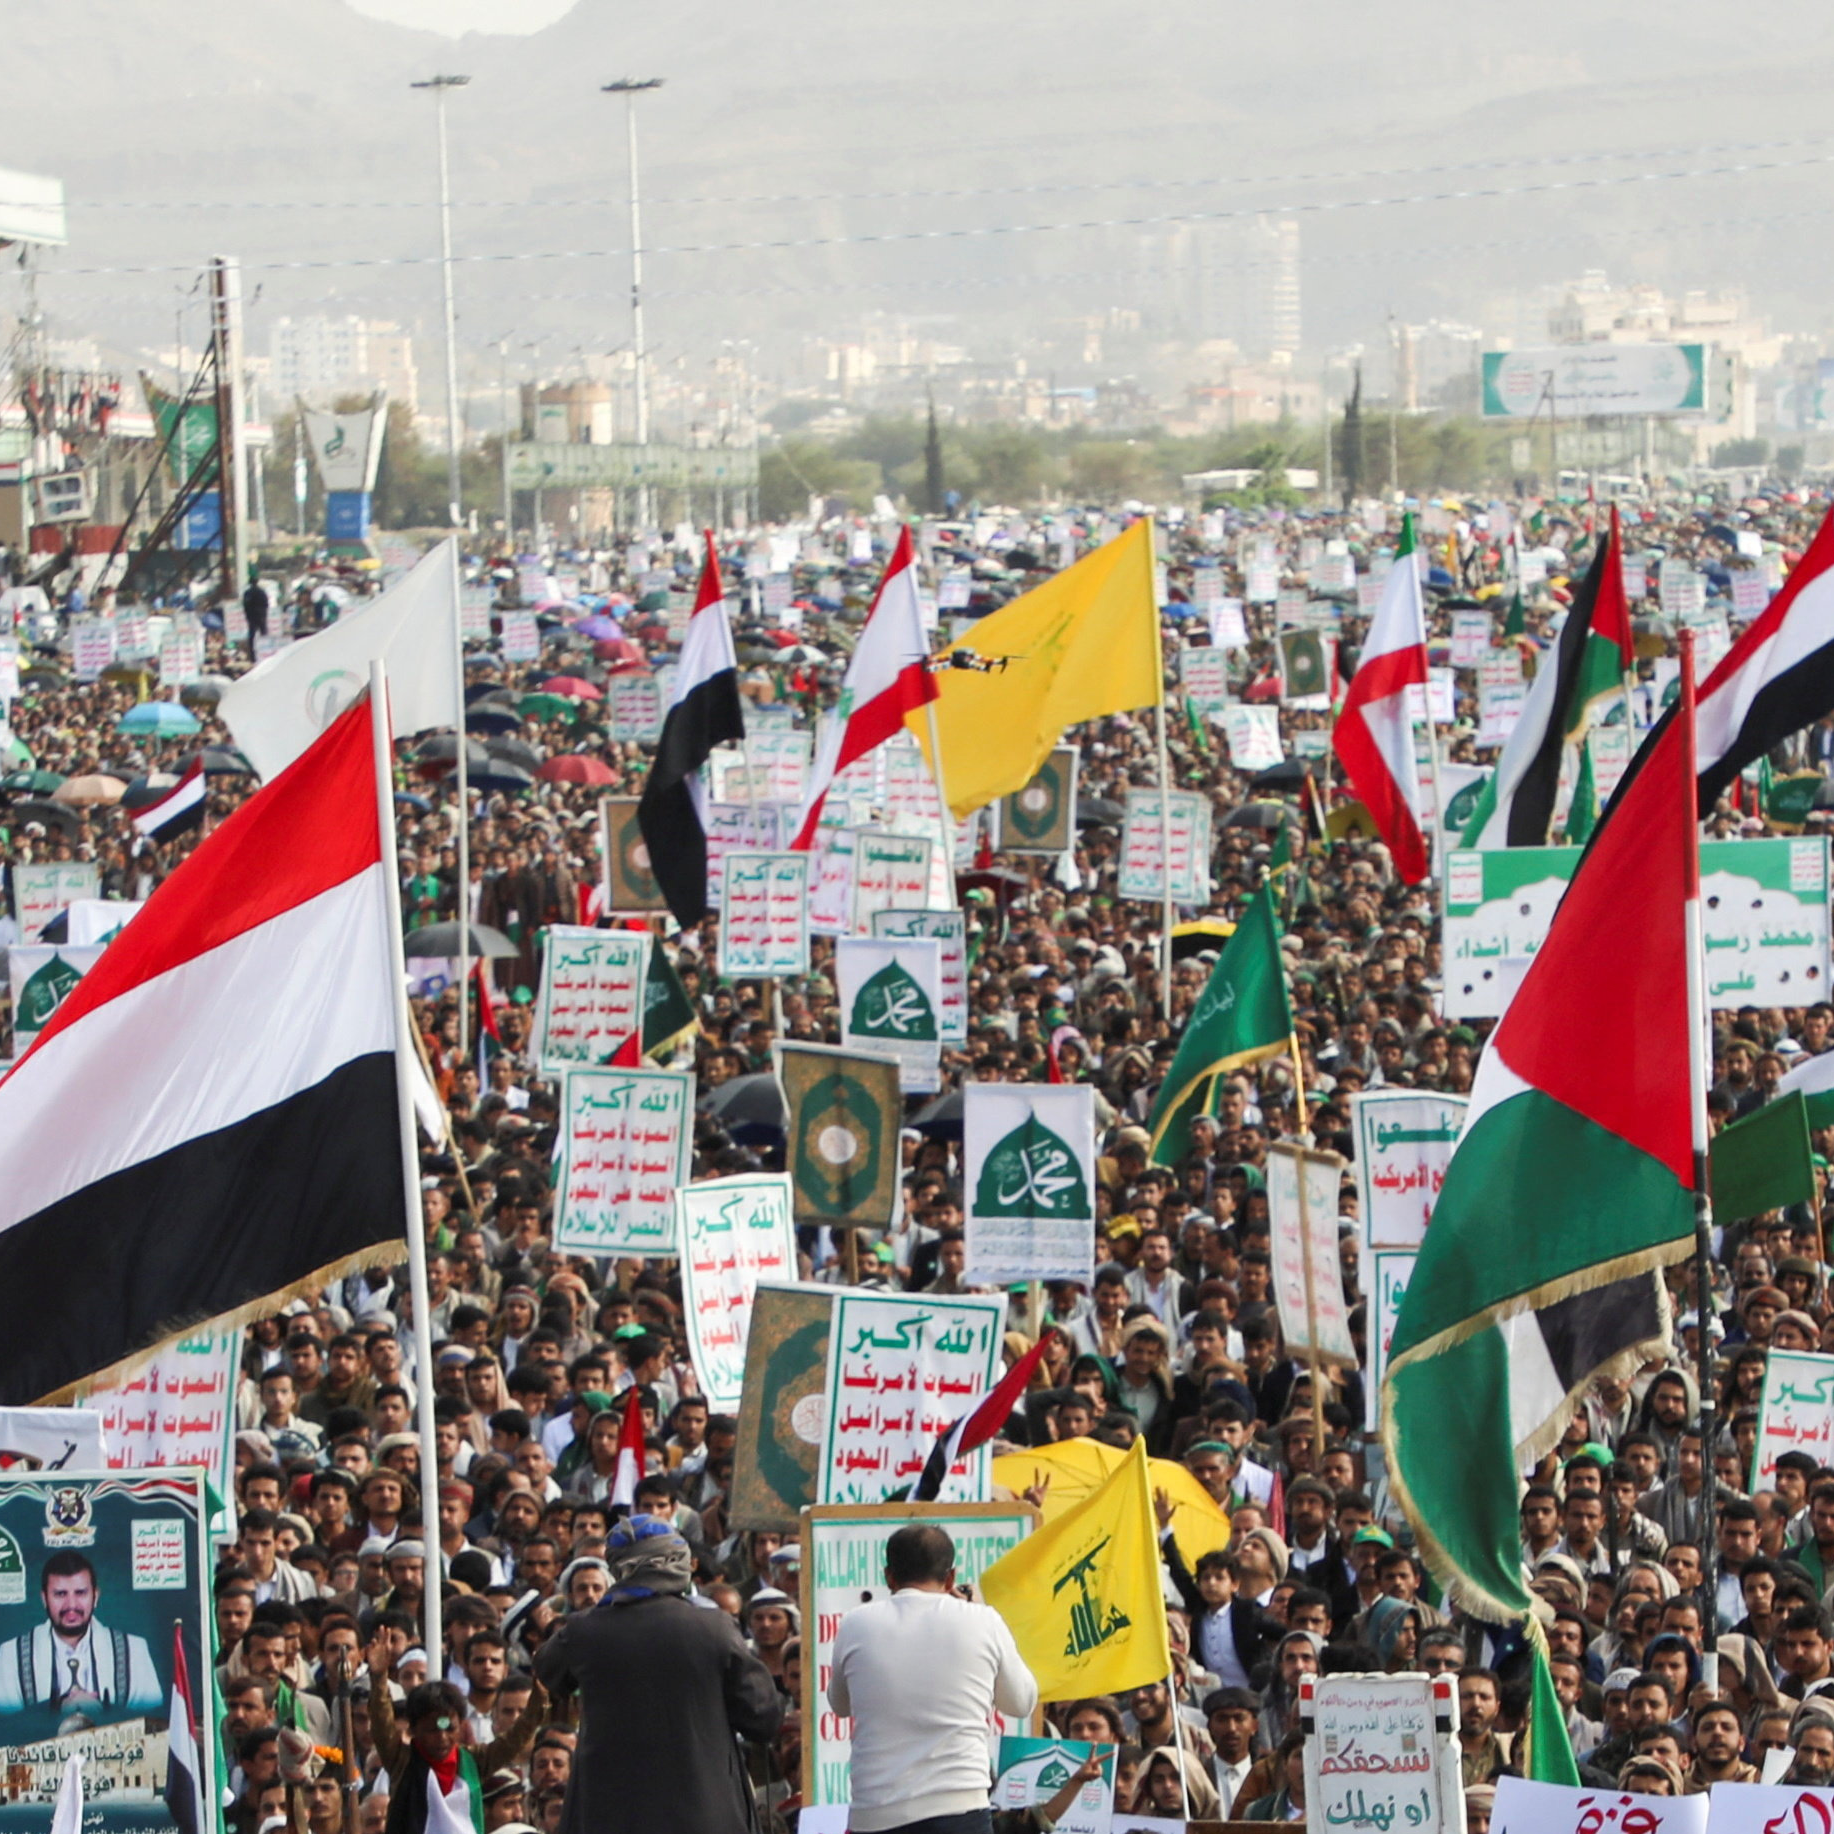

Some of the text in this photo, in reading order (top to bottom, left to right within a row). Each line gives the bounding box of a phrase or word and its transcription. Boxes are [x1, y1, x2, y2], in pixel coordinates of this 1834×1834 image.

[847, 1313, 988, 1359] الله أكبر
[844, 1364, 979, 1396] الموت لأمريكا
[818, 1541, 868, 1588] ALLAH
